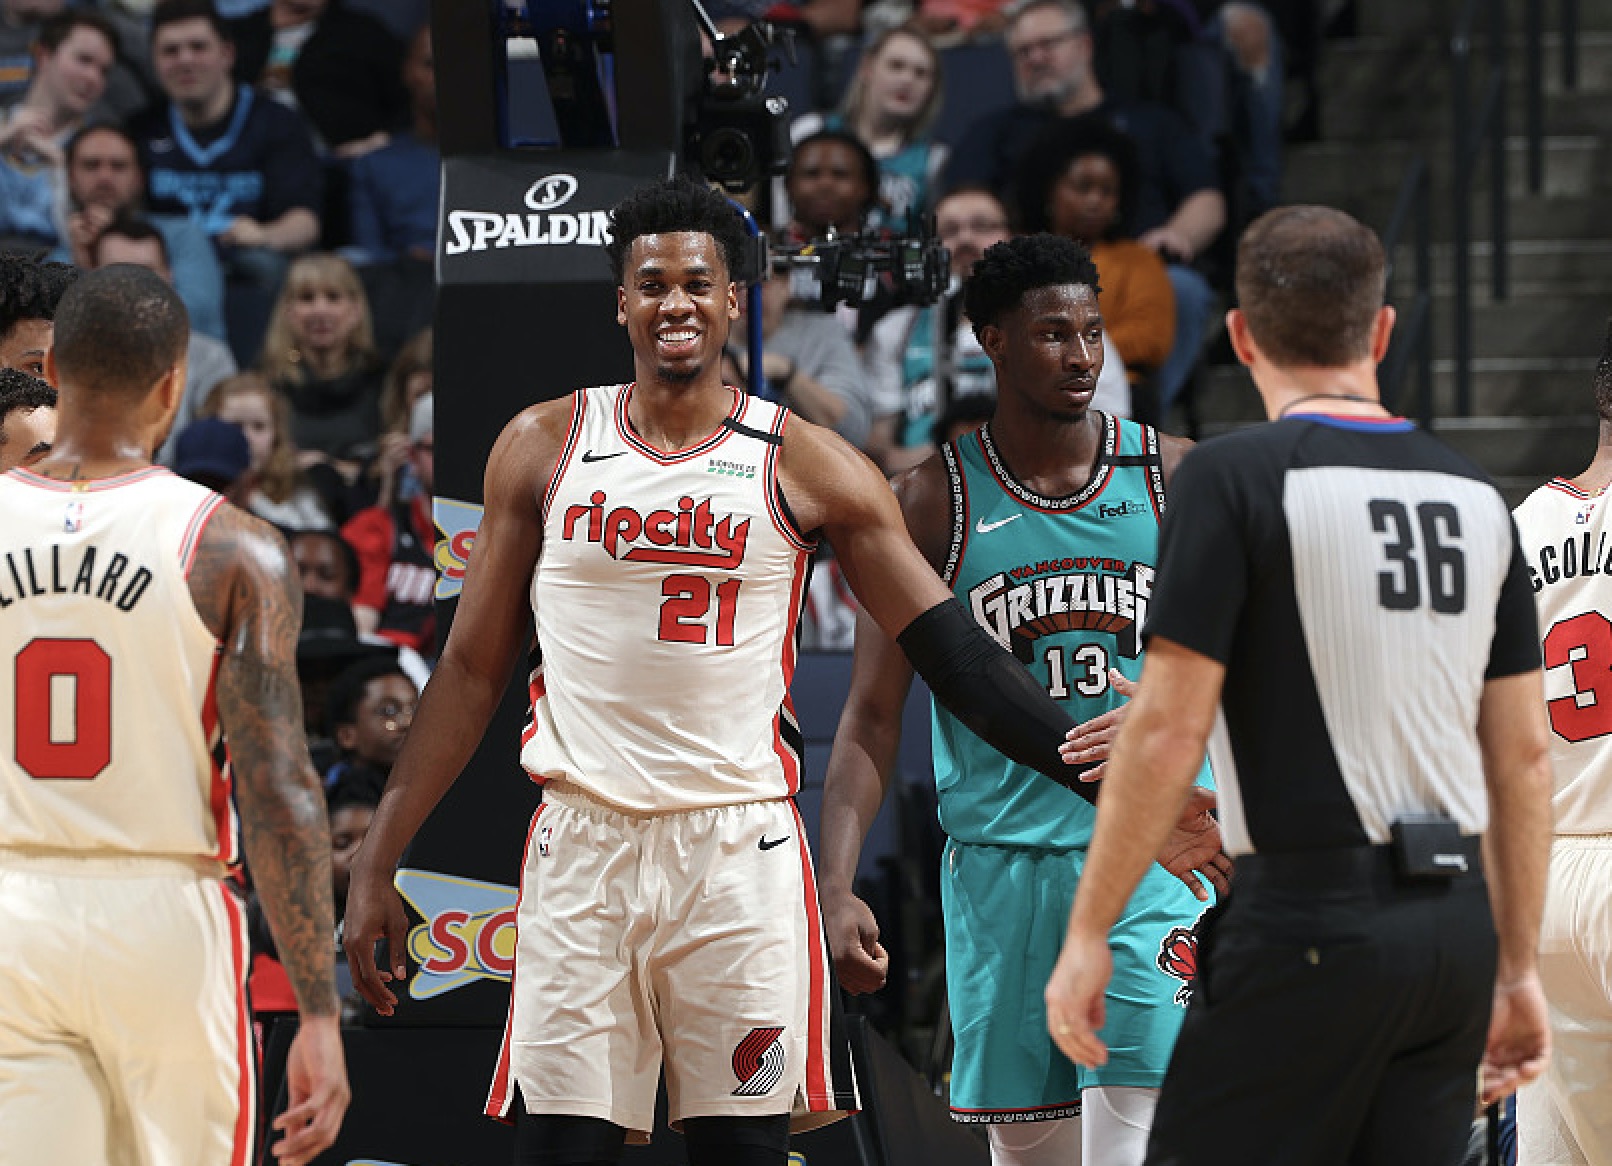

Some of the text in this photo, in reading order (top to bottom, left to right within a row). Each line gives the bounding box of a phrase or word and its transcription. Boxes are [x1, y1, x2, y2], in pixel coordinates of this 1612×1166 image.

[446, 210, 615, 255] SPALDIN
[1010, 556, 1127, 580] VANCOUVER
[1368, 498, 1467, 616] 36
[657, 573, 743, 647] 21
[15, 637, 113, 780] 0
[1044, 643, 1111, 700] 13
[1543, 609, 1612, 744] 3
